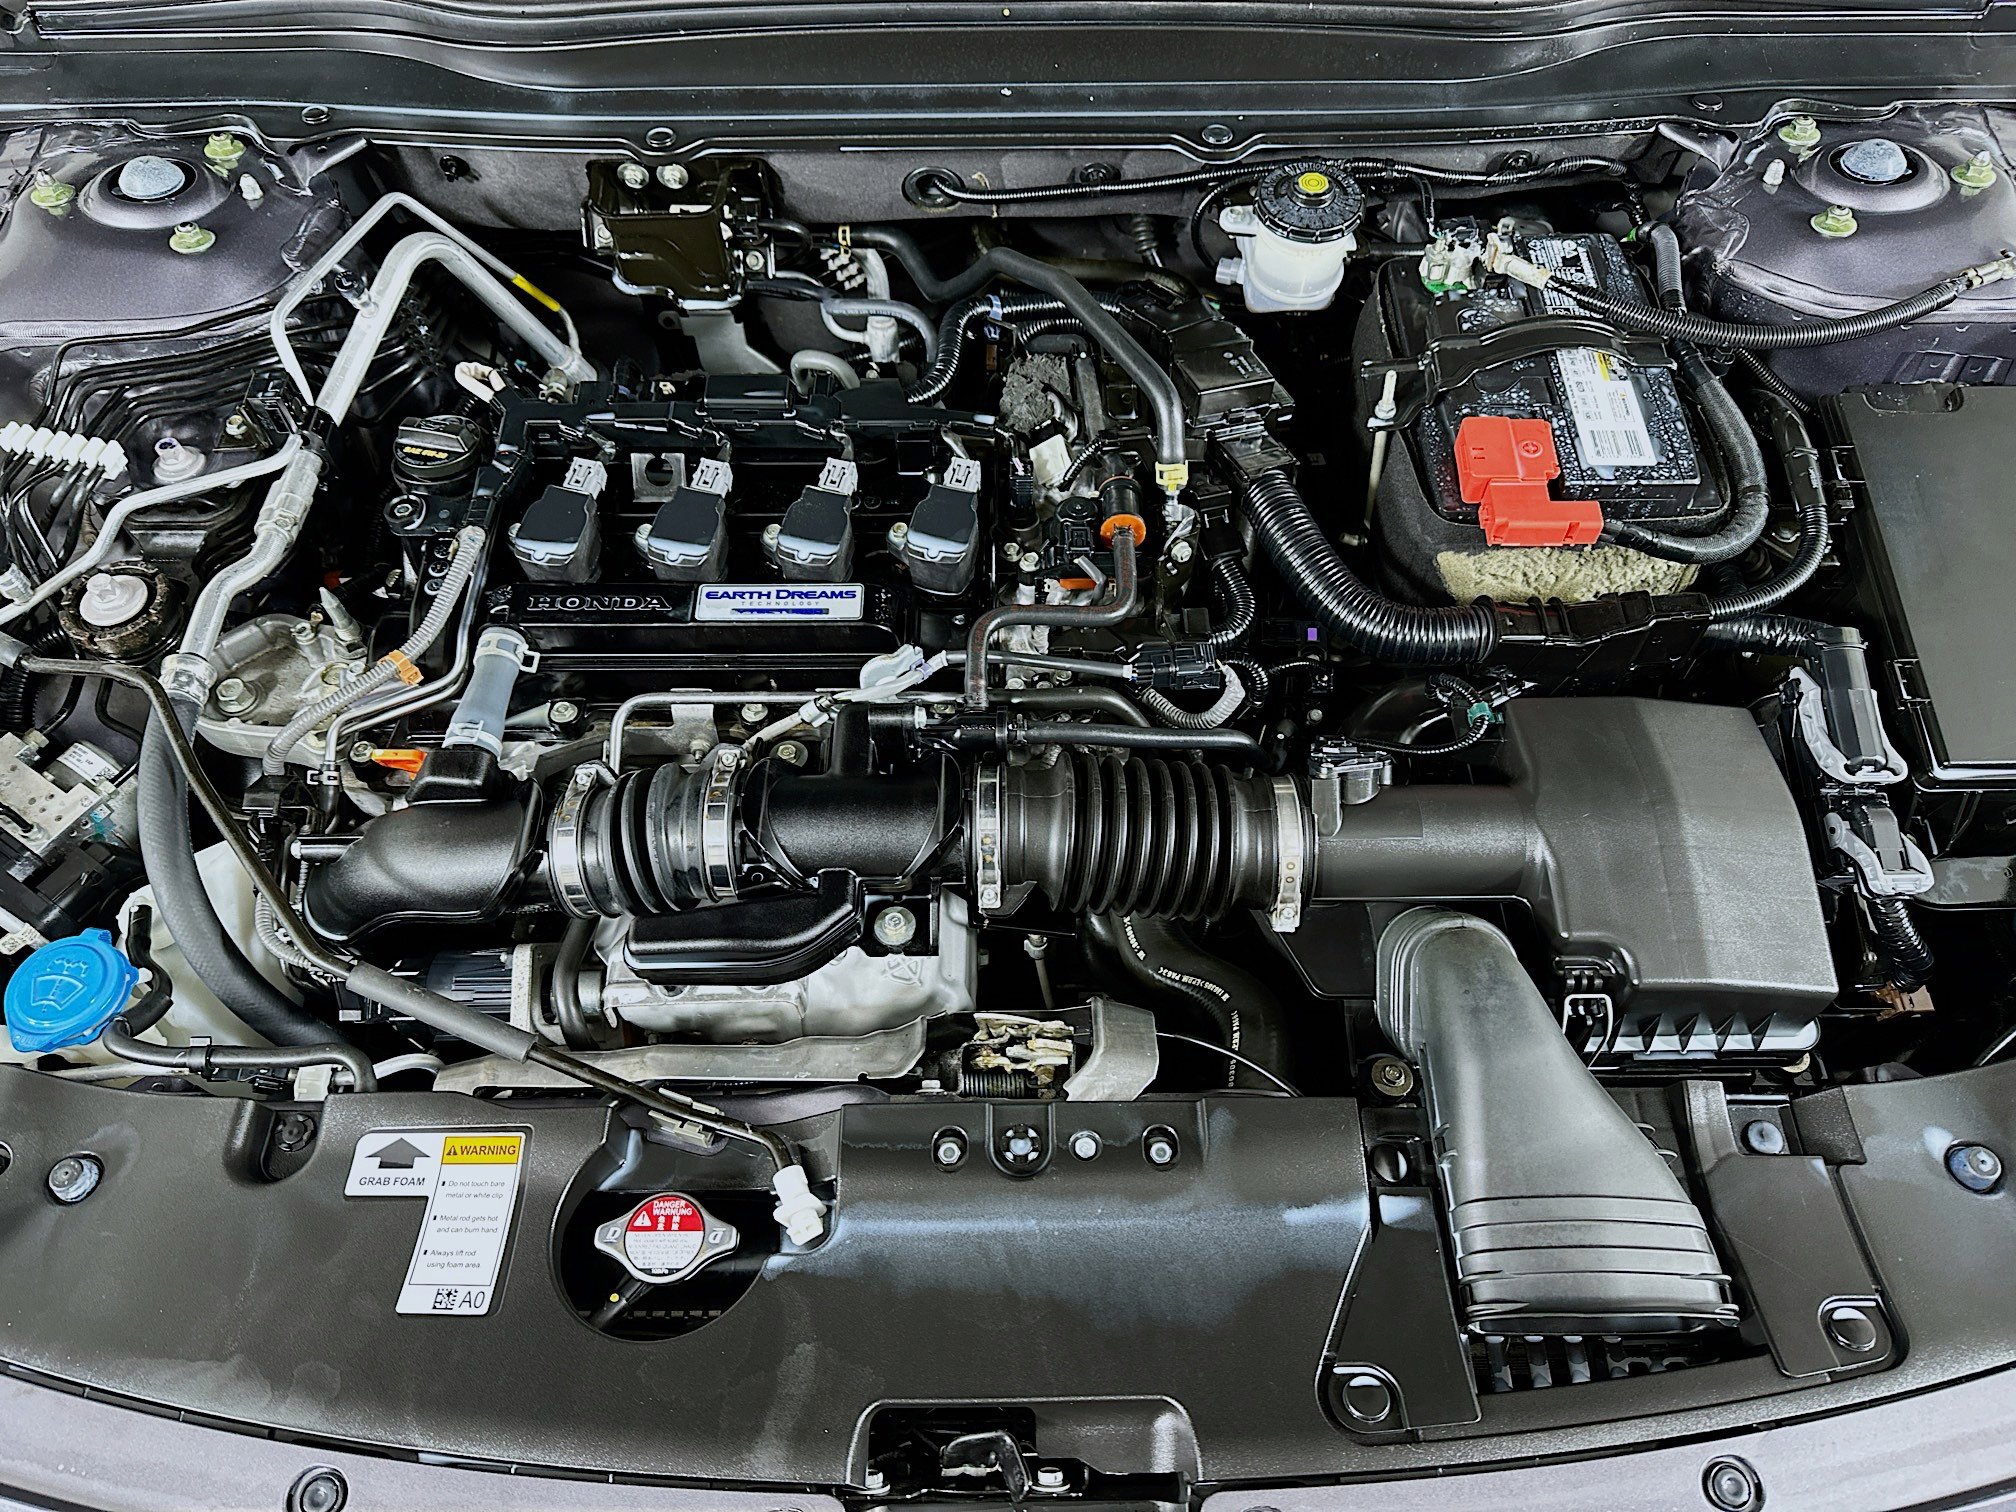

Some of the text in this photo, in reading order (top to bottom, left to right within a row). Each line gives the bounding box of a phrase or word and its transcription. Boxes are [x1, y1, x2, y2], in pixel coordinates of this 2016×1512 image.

[705, 589, 857, 600] EARTH DREAMS
[527, 594, 672, 611] HONDA
[460, 1145, 517, 1156] WARNING
[359, 1177, 426, 1186] GRAB FOAM
[653, 1200, 686, 1208] DANGER
[652, 1208, 693, 1216] WARNUNG
[458, 1291, 485, 1309] A0
